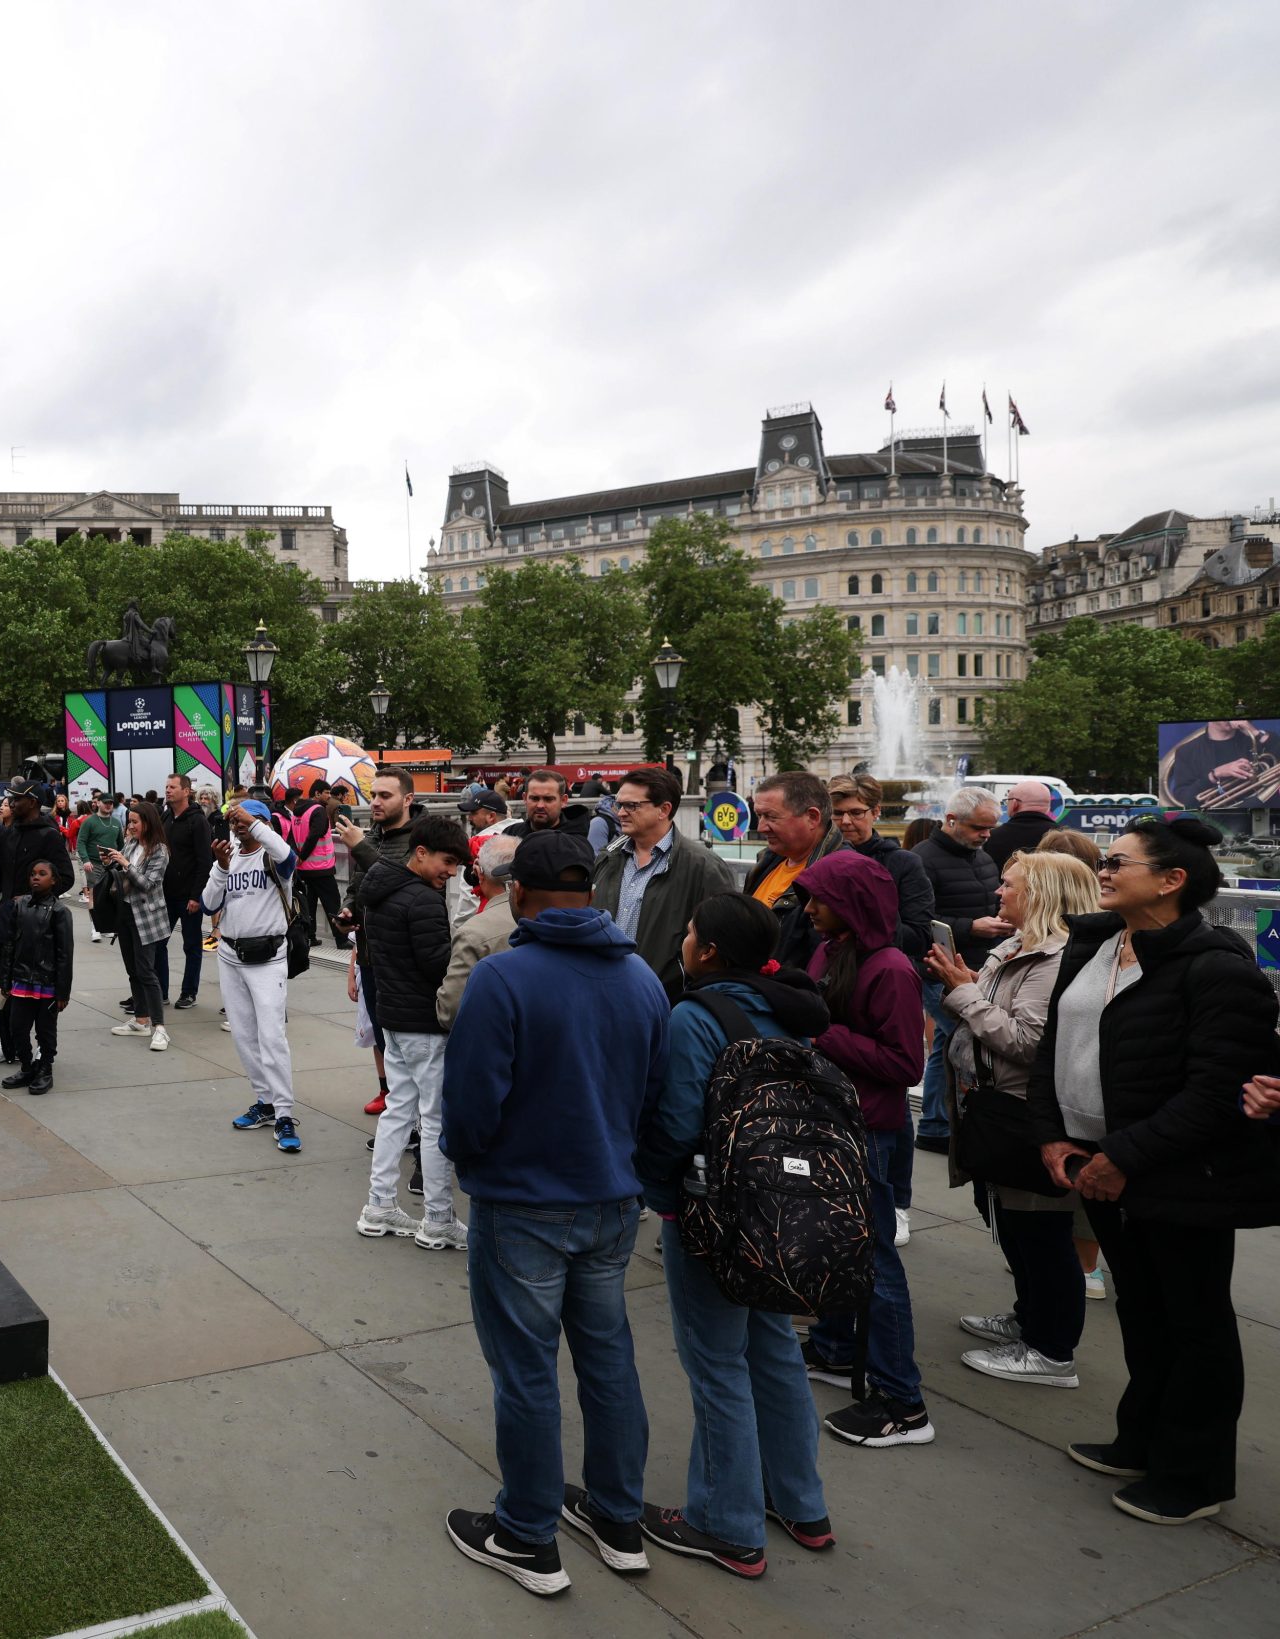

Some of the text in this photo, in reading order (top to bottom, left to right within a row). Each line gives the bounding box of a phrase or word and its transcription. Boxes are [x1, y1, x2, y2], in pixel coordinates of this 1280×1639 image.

[153, 719, 166, 730] 24
[178, 730, 217, 738] CHAMPIONS
[70, 735, 107, 743] CHAMPIONS
[717, 806, 736, 822] BVB
